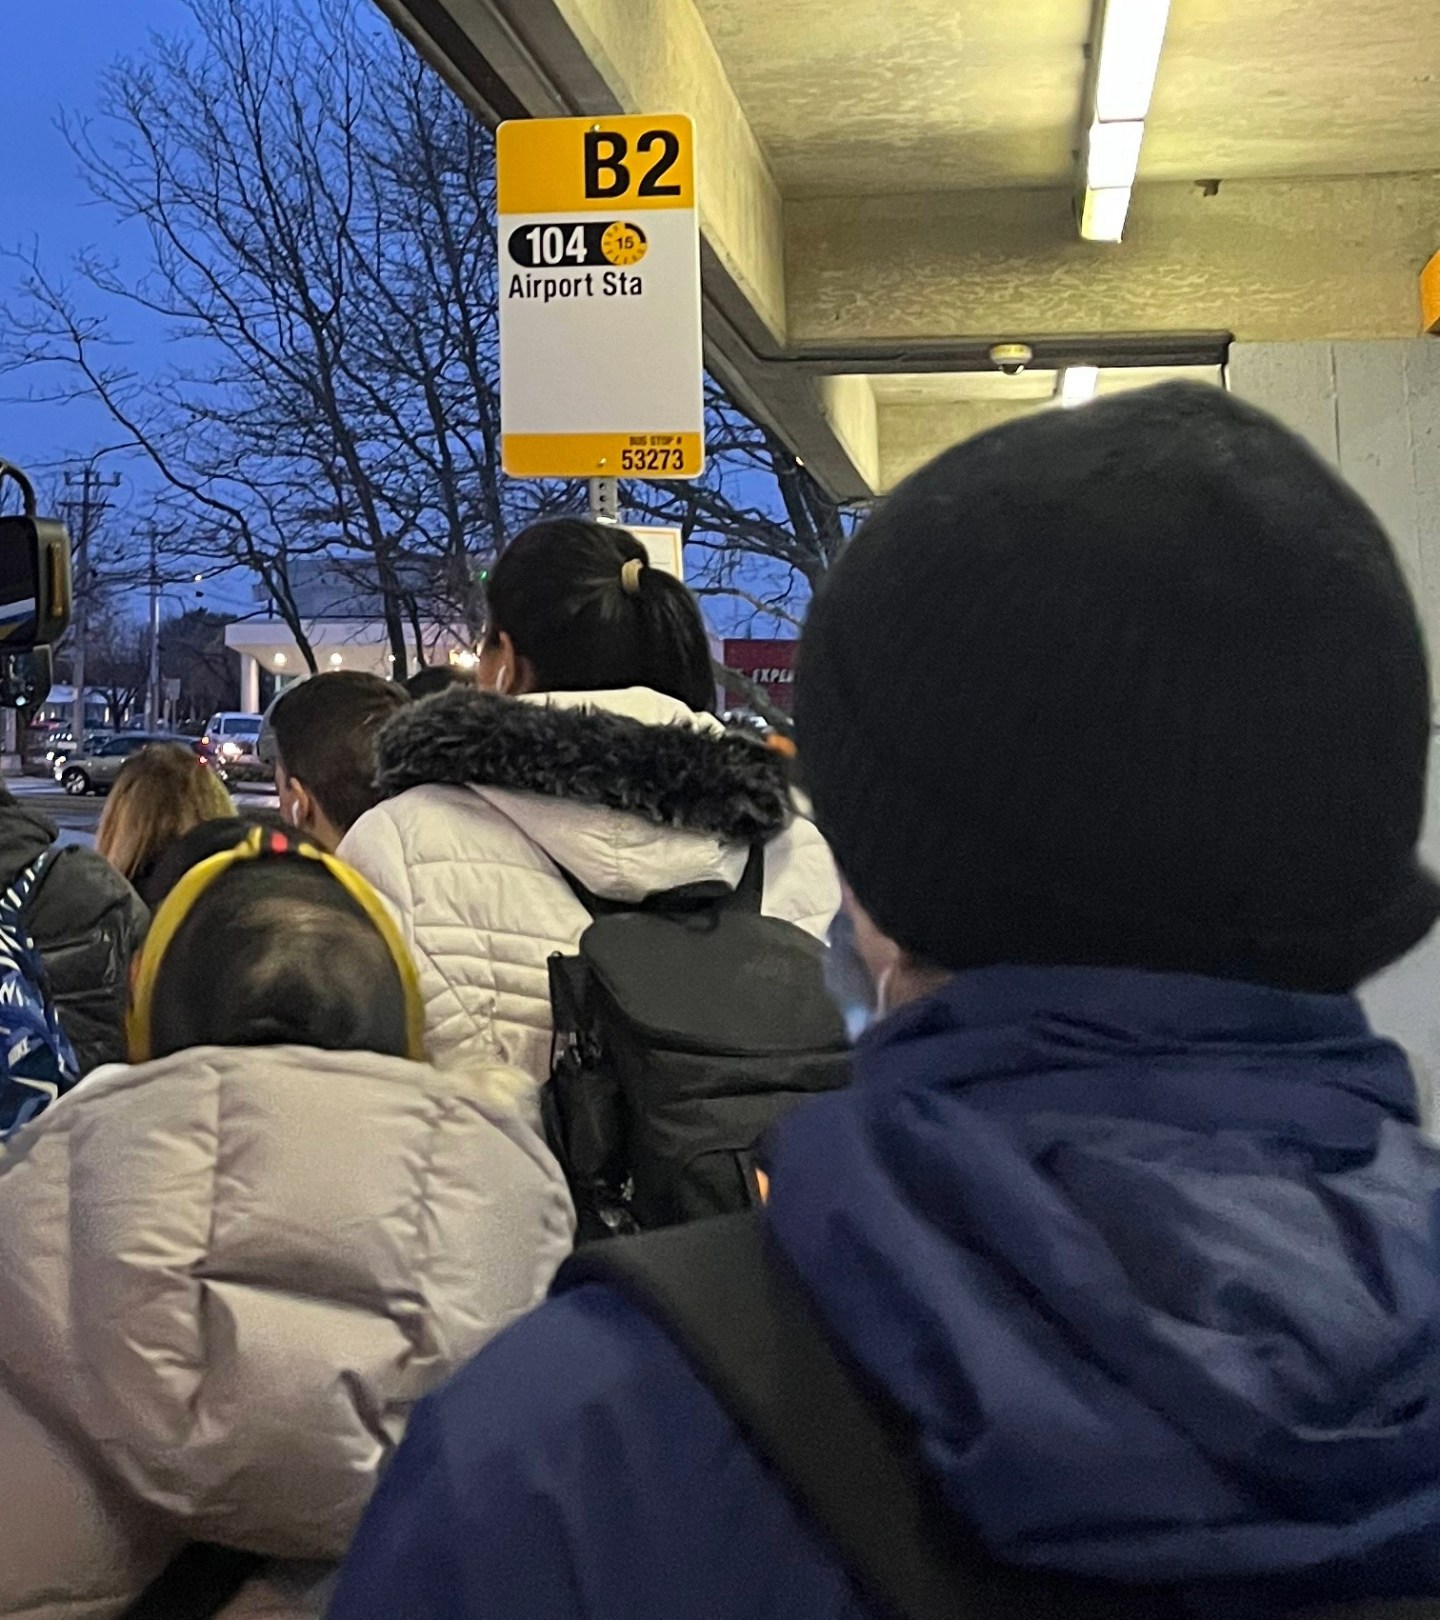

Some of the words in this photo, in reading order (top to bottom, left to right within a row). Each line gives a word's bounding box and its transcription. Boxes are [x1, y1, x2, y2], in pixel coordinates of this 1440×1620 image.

[584, 130, 681, 199] B2
[526, 226, 587, 265] 104
[616, 237, 634, 250] 15
[509, 273, 593, 303] Airport
[603, 271, 642, 296] Sta
[622, 449, 684, 470] 53273
